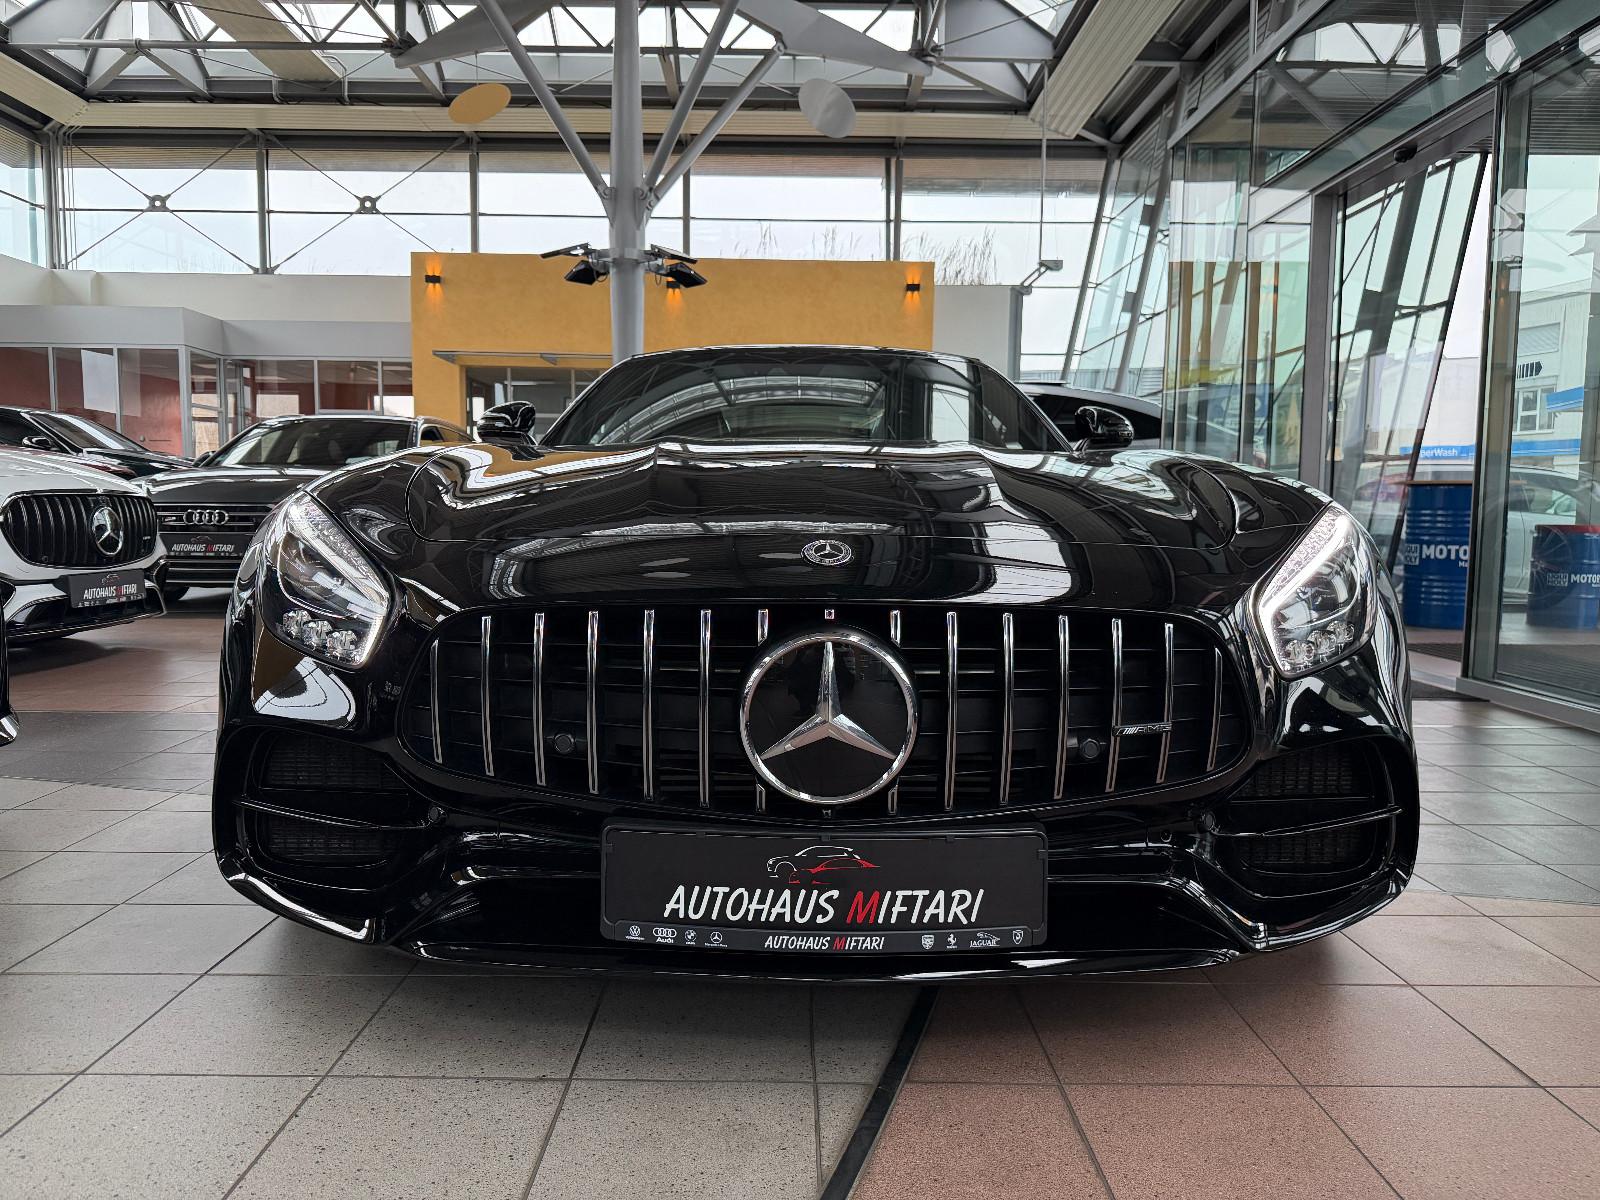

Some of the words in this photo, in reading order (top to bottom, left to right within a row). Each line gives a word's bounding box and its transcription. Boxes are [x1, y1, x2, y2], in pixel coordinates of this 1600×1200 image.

[1419, 447, 1458, 458] perWash
[171, 543, 206, 552] AUTOHAUS
[207, 544, 235, 552] MIFTARI
[1421, 544, 1469, 560] MOTO
[83, 586, 117, 600] AUTOHAUS
[663, 885, 840, 924] AUTOHAUS
[846, 888, 985, 924] MIFTARI
[655, 936, 674, 944] Audi
[764, 935, 831, 950] AUTOHAUS
[833, 936, 885, 950] MIFTARI
[970, 939, 998, 948] JAGUAR
